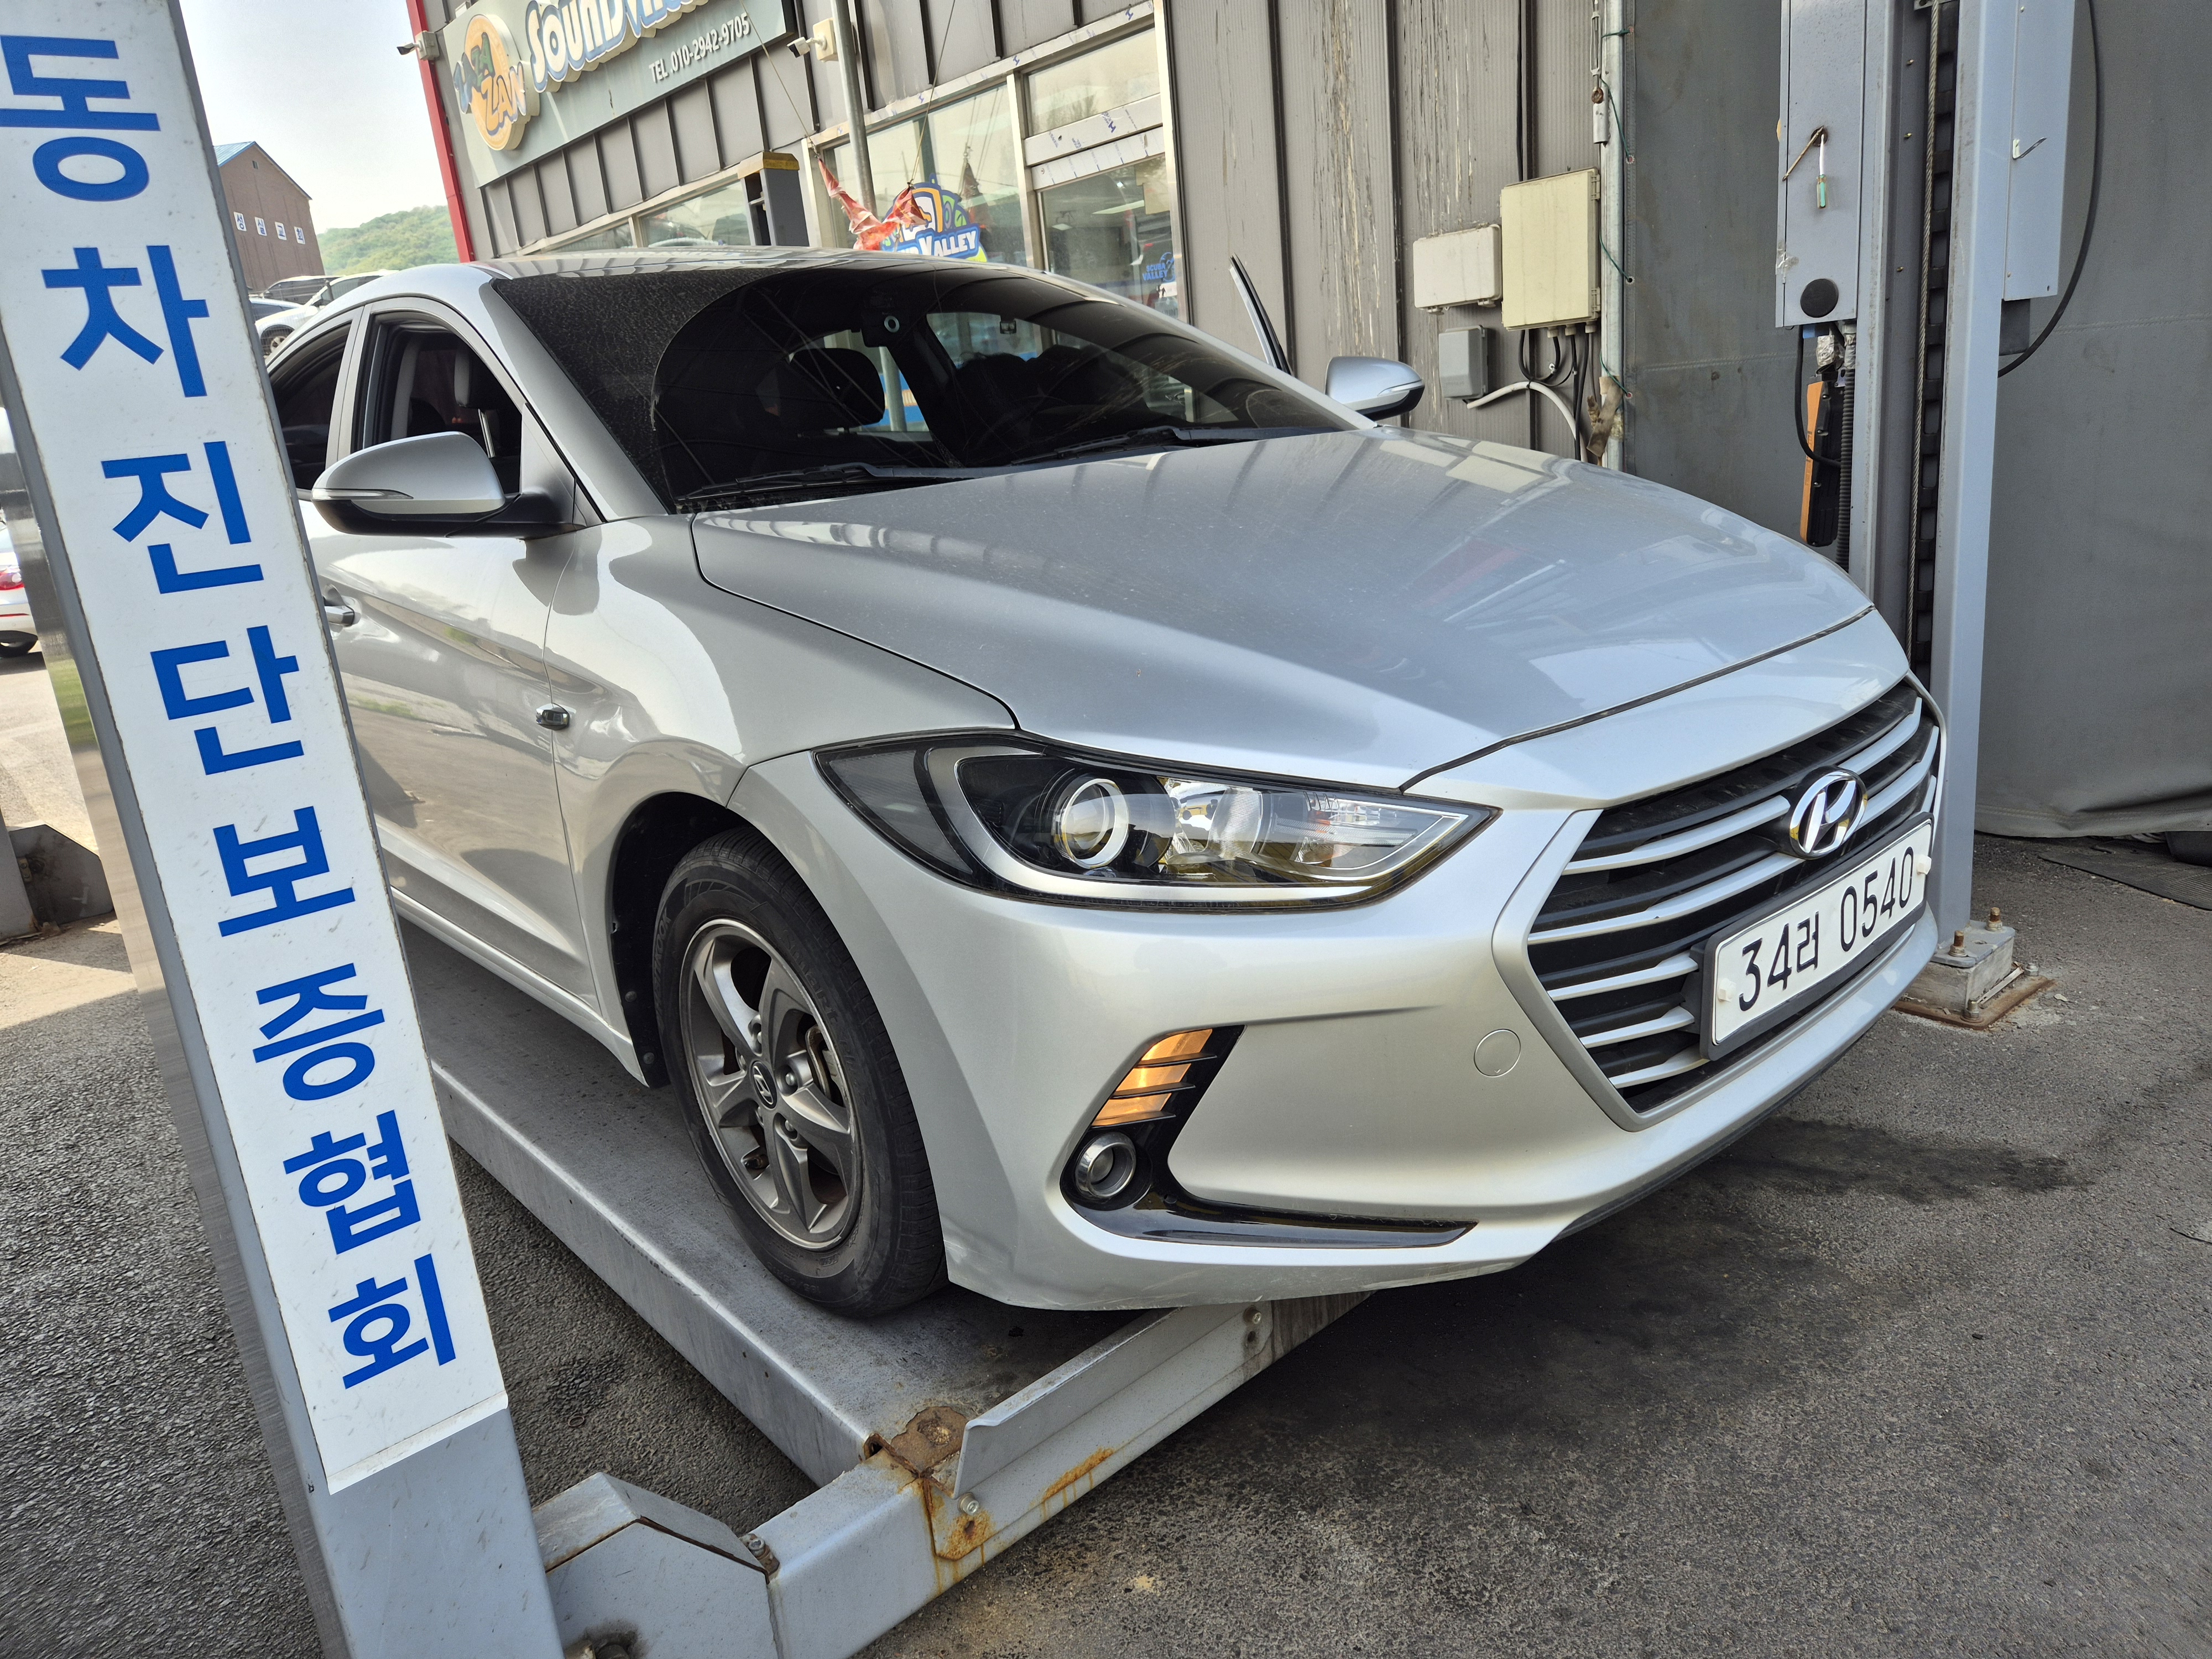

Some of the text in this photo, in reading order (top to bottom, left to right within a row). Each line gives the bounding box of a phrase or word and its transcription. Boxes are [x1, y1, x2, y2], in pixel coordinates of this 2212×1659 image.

[918, 230, 977, 257] VALLEY
[1142, 270, 1168, 281] VALLEY
[1146, 263, 1166, 272] SCUBA
[1739, 846, 1914, 1011] 34러 0540
